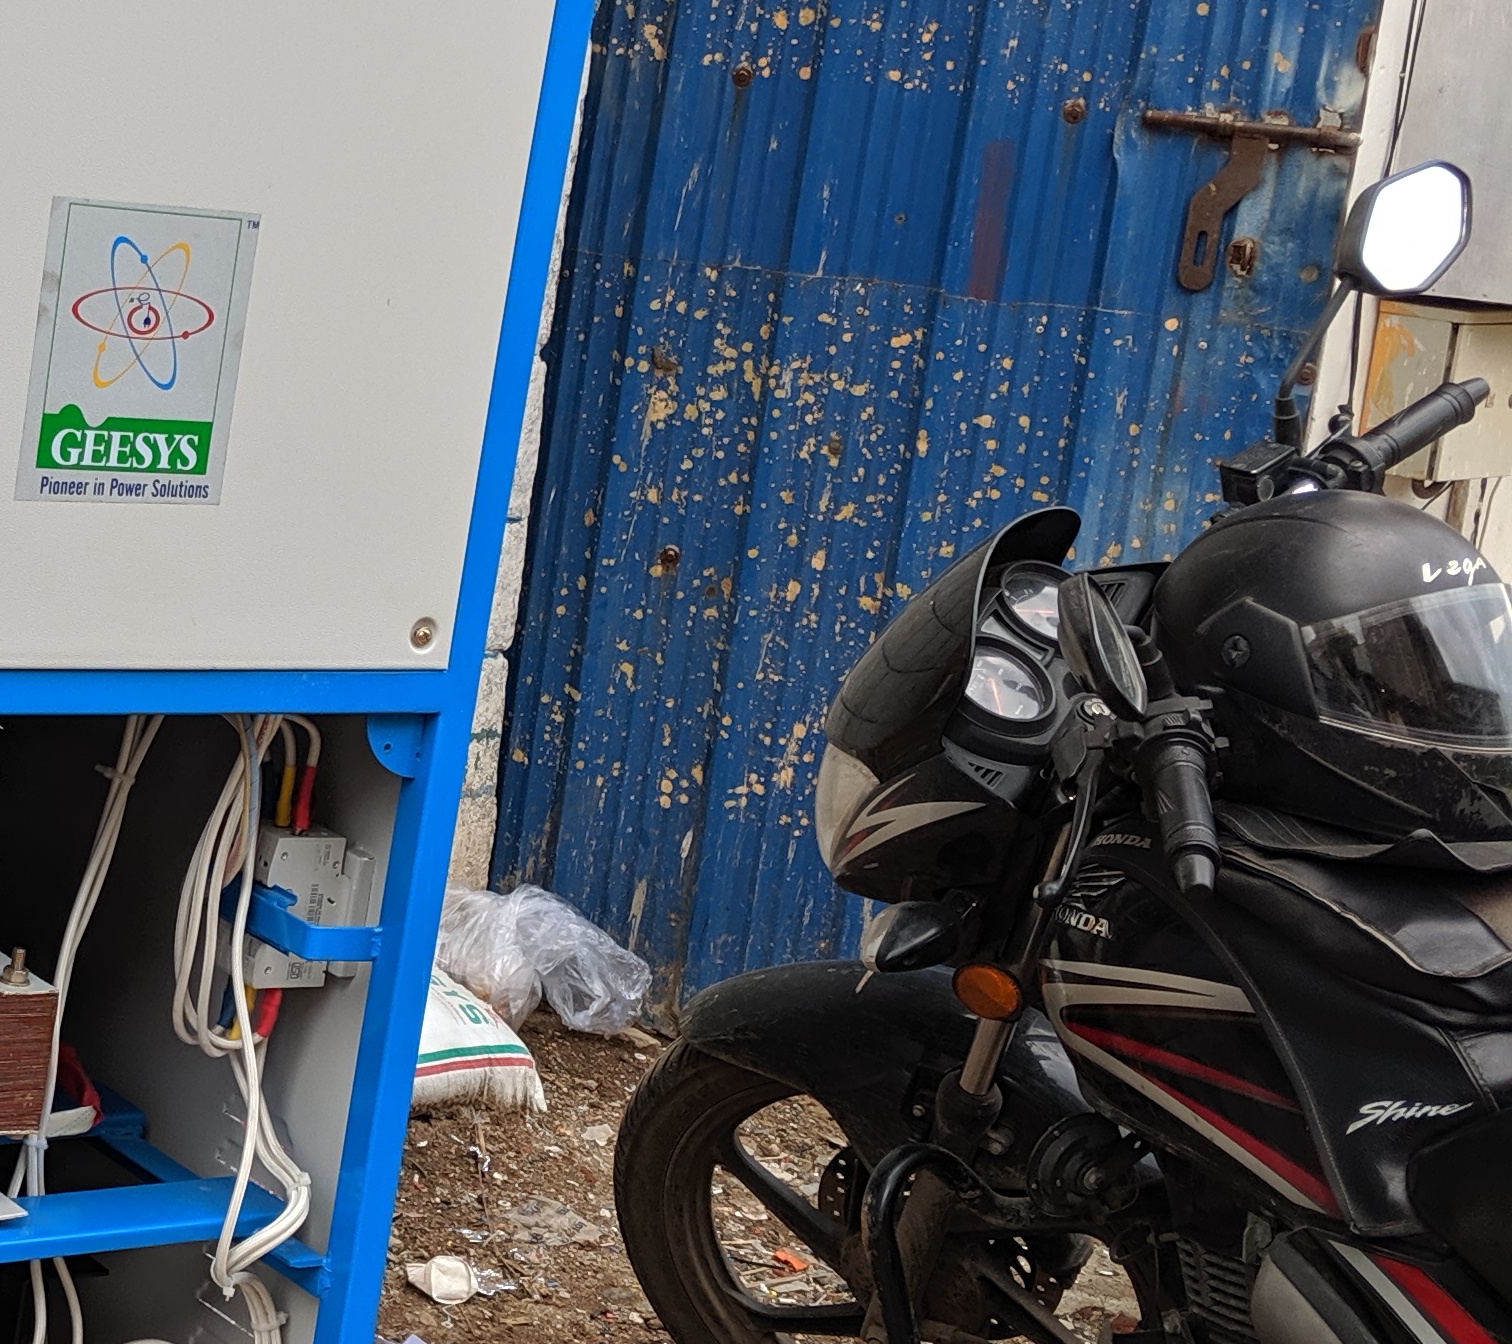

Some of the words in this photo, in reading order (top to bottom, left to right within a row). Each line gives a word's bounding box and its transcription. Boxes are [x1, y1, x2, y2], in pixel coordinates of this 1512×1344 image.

[51, 428, 199, 471] GEESYS
[40, 476, 90, 496] Pioneer
[93, 477, 105, 496] in
[110, 478, 149, 498] Power
[151, 479, 210, 499] Solutions
[1091, 833, 1152, 849] HONDA
[1345, 1100, 1473, 1135] Shine
